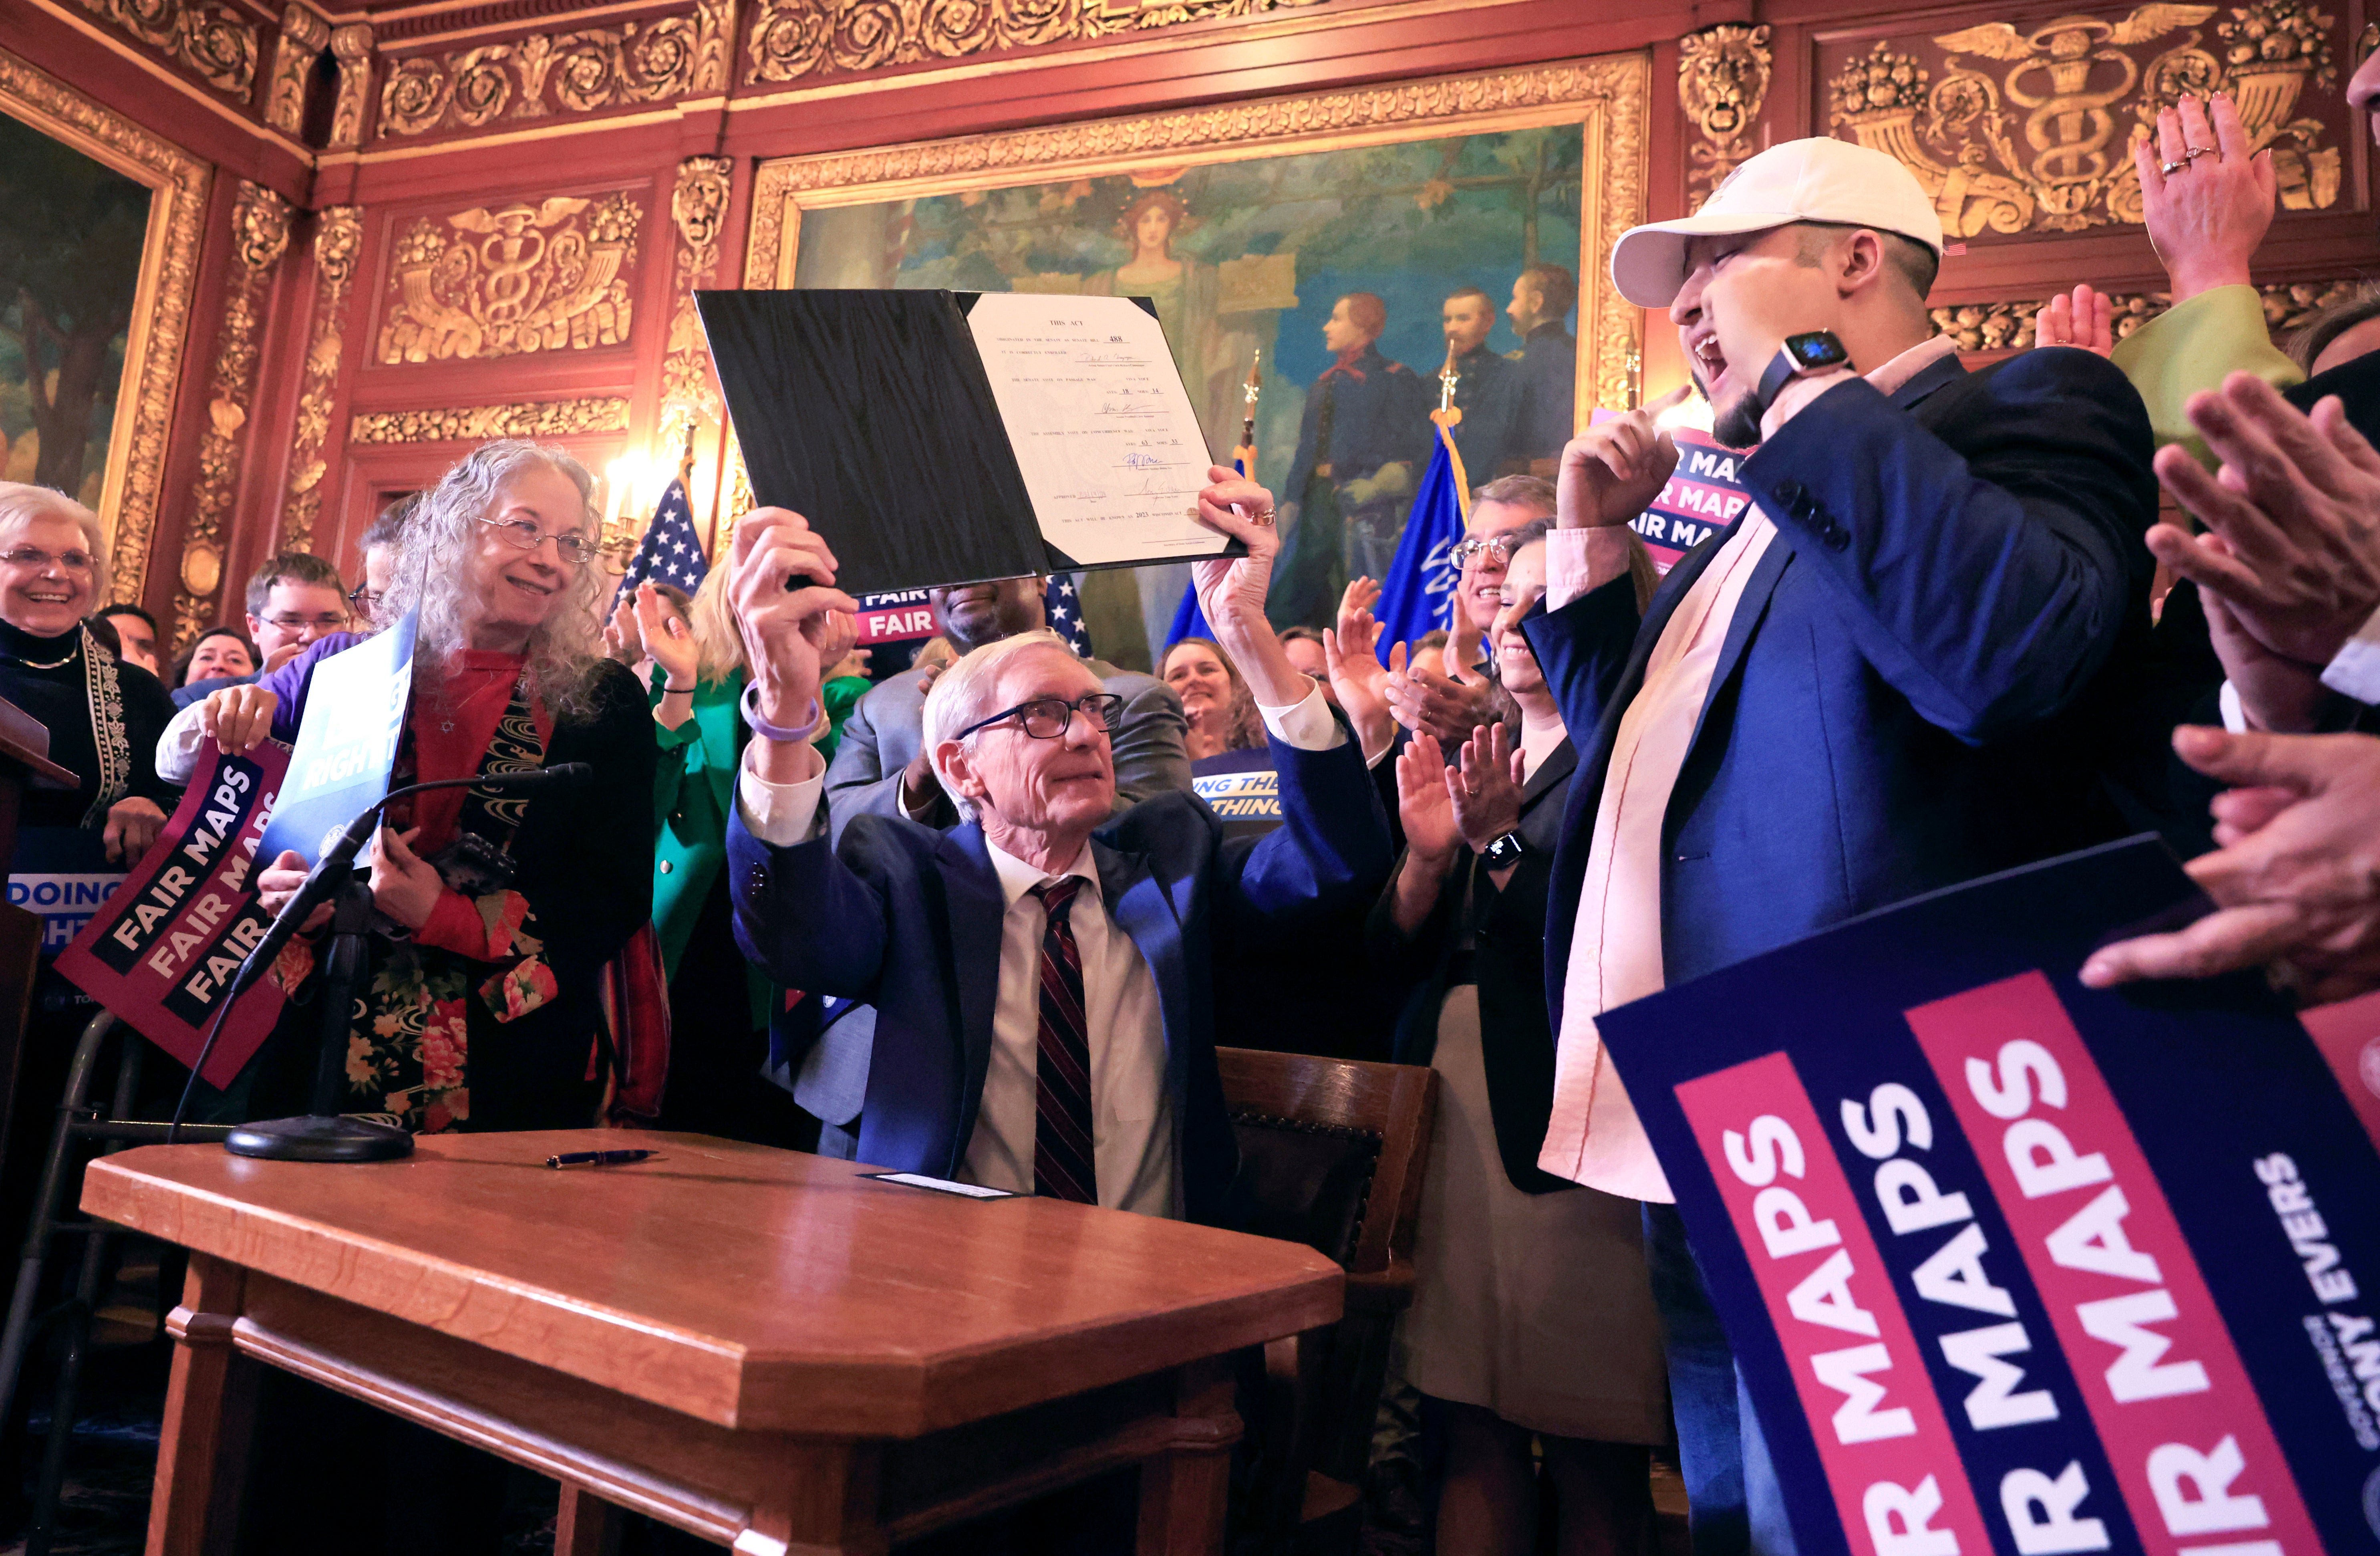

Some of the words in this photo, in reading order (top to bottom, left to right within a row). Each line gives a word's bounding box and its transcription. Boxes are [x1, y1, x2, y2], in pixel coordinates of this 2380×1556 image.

[1678, 486, 1745, 519] MAP
[1689, 451, 1740, 484] MA
[1627, 513, 1666, 539] IR
[1671, 520, 1712, 547] MA
[869, 611, 933, 637] FAIR
[1193, 779, 1232, 793] ING
[113, 866, 196, 951] FAIR
[183, 765, 250, 866] MAPS
[148, 893, 232, 979] FAIR
[185, 917, 270, 1004] FAIR
[1840, 1082, 2060, 1431] MAPS
[1963, 1039, 2211, 1404] MAPS
[2254, 1153, 2358, 1303] EVERS
[1722, 1114, 1919, 1446] MAPS
